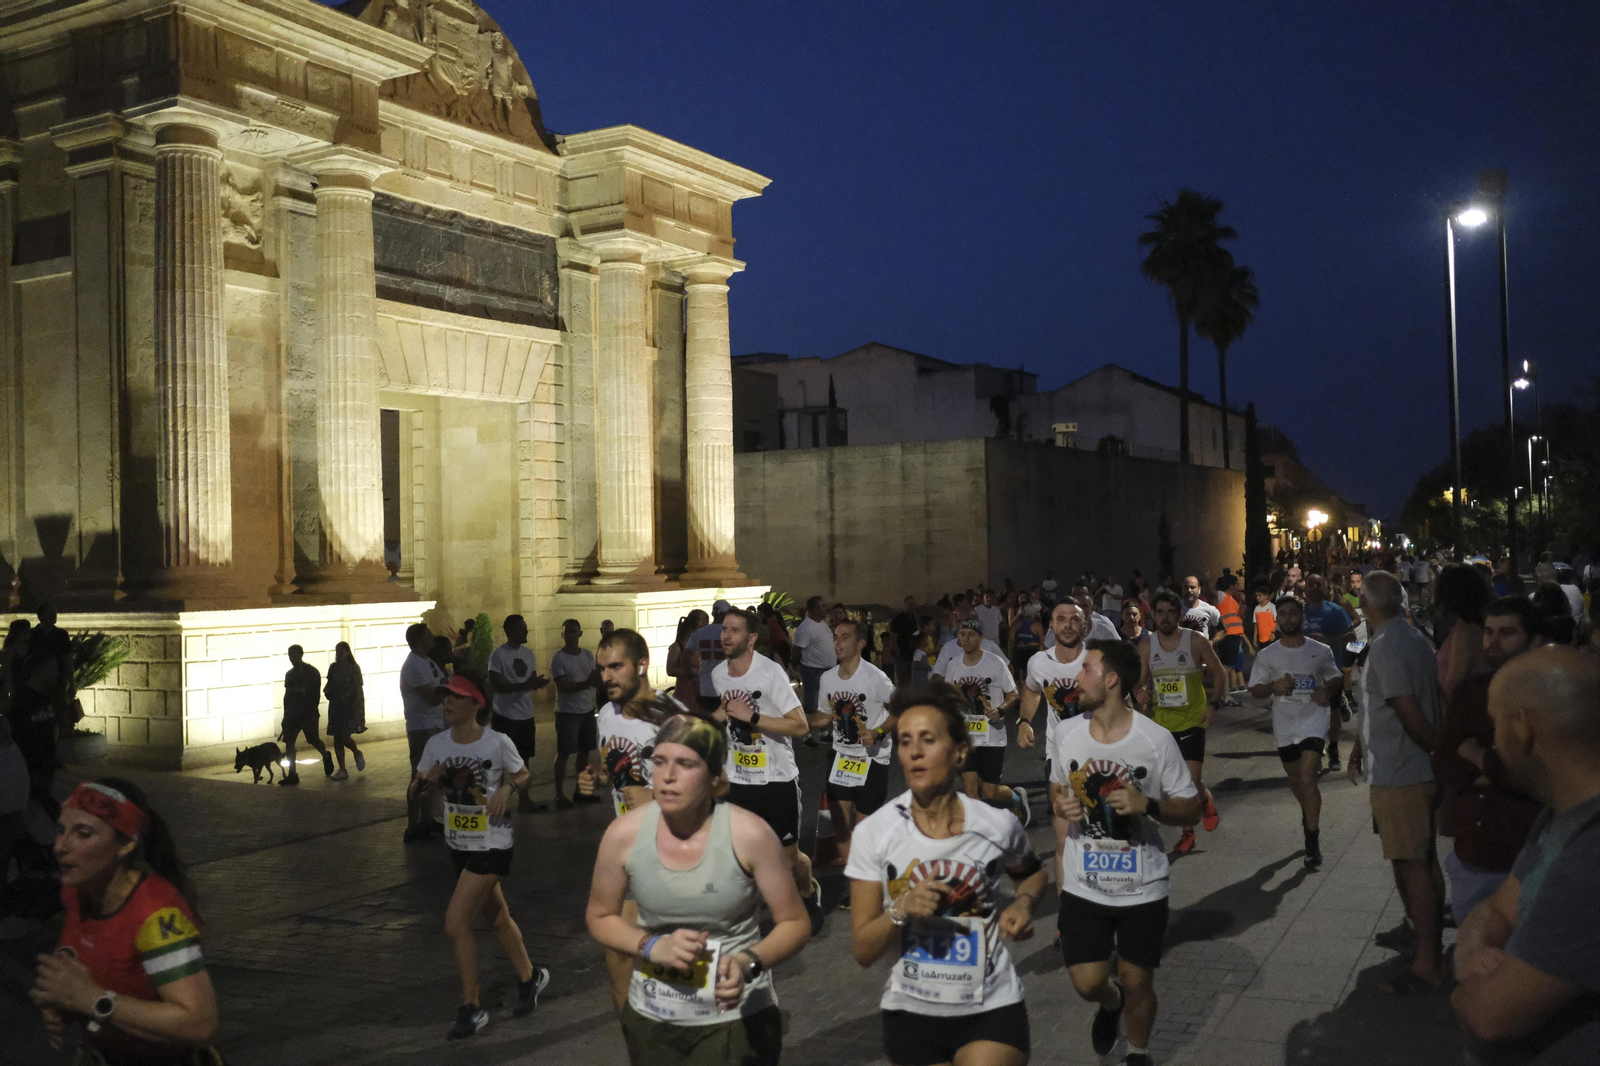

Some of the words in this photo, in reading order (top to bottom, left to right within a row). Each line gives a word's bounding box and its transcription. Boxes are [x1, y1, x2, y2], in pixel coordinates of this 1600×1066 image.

[1161, 682, 1179, 692] 206
[738, 753, 759, 766] 269
[842, 760, 862, 773] 271
[454, 815, 479, 829] 625
[1087, 852, 1133, 870] 2075
[158, 913, 185, 940] K
[920, 969, 973, 981] laArruzafa
